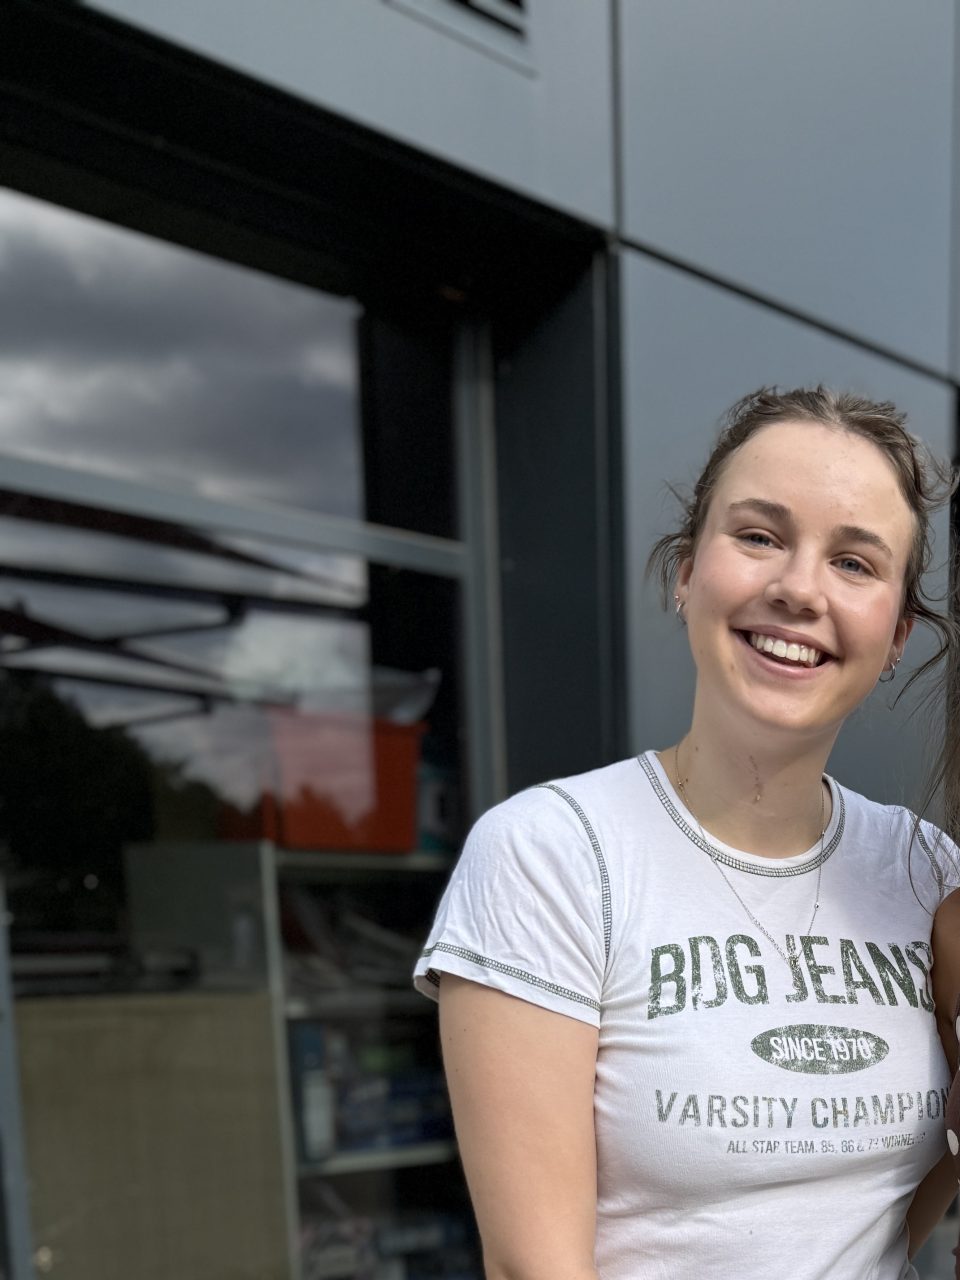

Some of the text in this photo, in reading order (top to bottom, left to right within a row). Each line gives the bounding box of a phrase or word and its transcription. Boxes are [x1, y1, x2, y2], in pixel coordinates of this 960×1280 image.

[647, 934, 935, 1020] BDG JEANS
[769, 1037, 873, 1062] SINCE 1970
[655, 1089, 798, 1128] VARSITY
[726, 1140, 748, 1154] ALL
